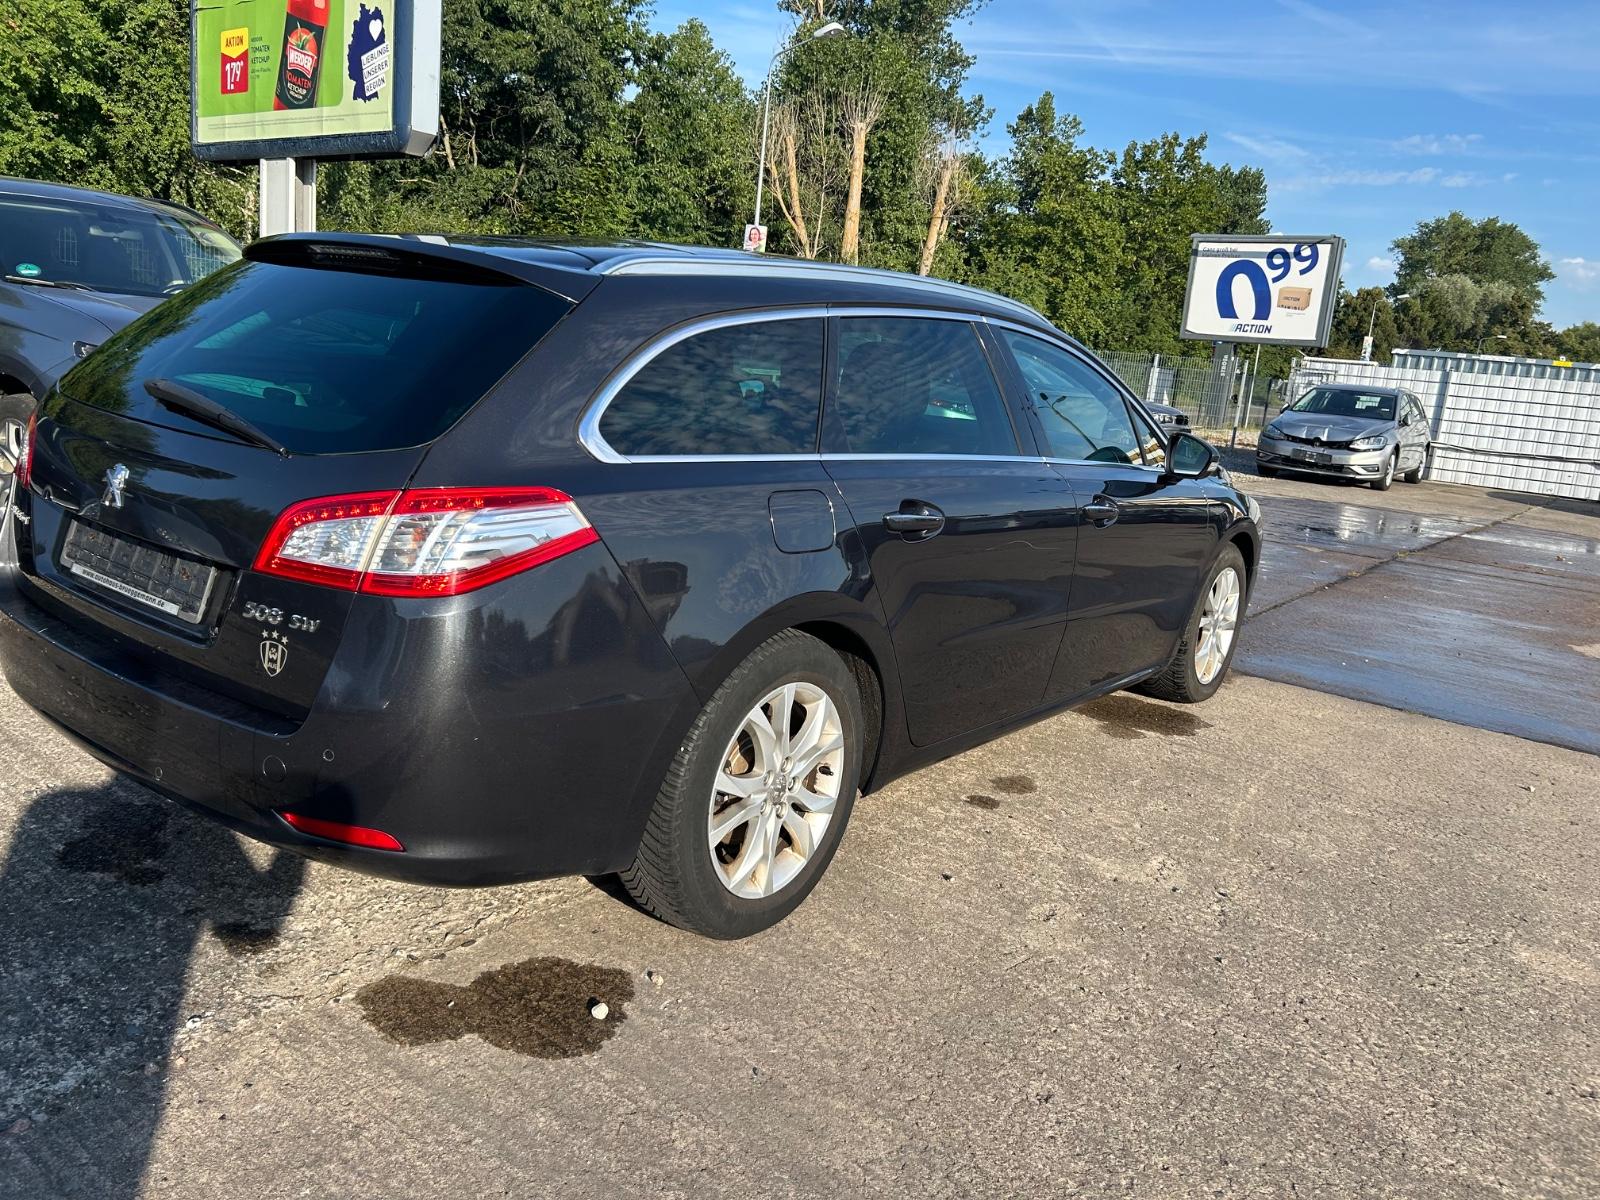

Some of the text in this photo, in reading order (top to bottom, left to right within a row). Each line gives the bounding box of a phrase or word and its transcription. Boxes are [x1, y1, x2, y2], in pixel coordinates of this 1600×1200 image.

[225, 35, 244, 47] AKTION
[250, 44, 270, 53] TOMATEN
[251, 55, 270, 64] KETCHUP
[289, 47, 313, 70] WERDER
[363, 43, 389, 66] LIEBLINGE
[364, 59, 389, 80] UNSERER
[286, 71, 312, 88] TOMATEN
[366, 76, 386, 92] REGION
[1234, 323, 1273, 334] ACTION
[82, 568, 165, 608] www.autohaus-brueggemann.de
[242, 601, 320, 632] 508 SW
